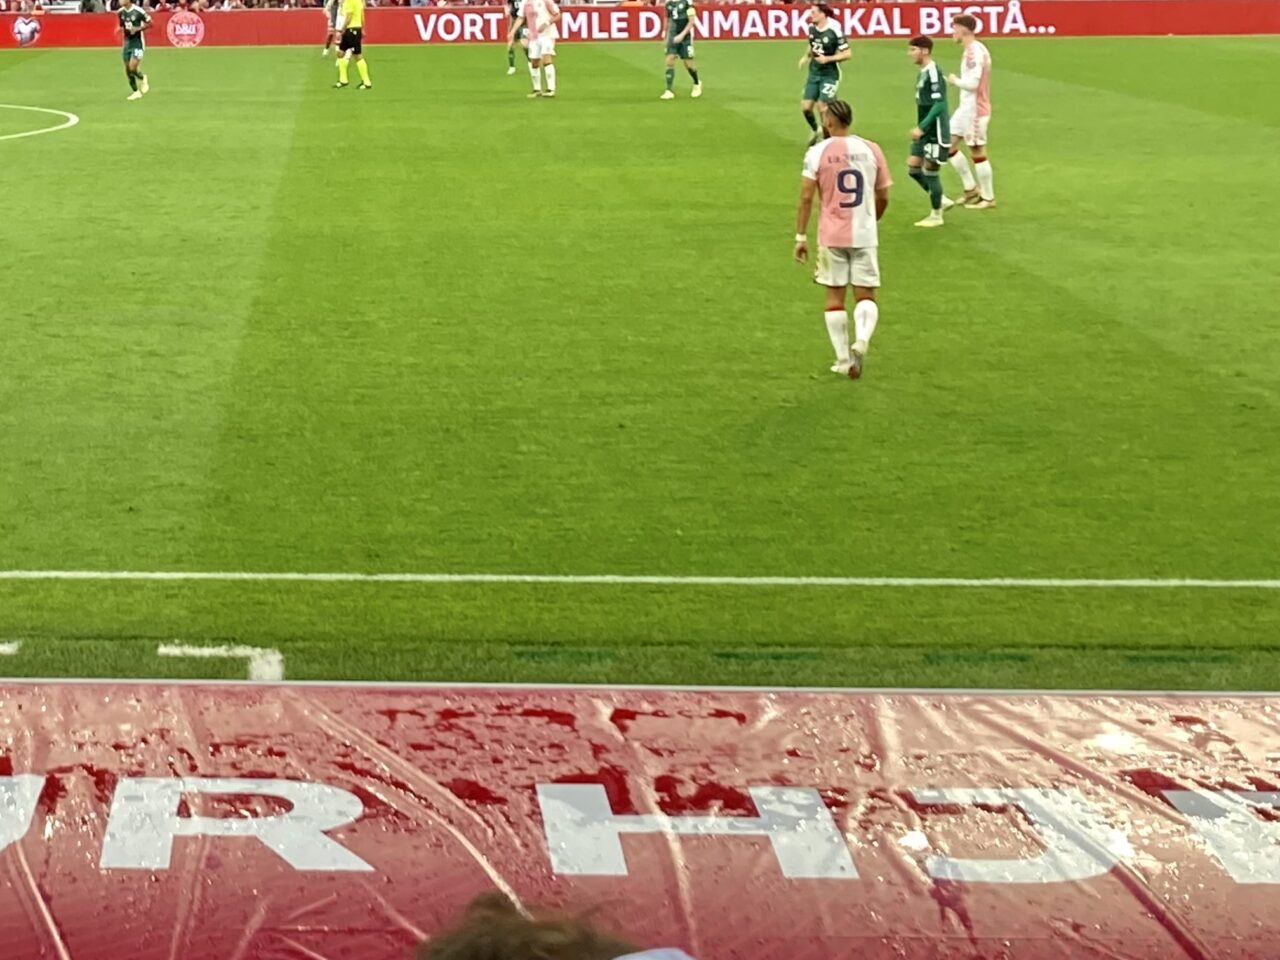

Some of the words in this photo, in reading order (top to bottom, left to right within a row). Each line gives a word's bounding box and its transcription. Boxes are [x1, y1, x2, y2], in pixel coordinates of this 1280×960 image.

[415, 12, 504, 40] VORT
[556, 10, 629, 39] MLE
[638, 8, 811, 39] DNMARK
[837, 169, 864, 208] 9
